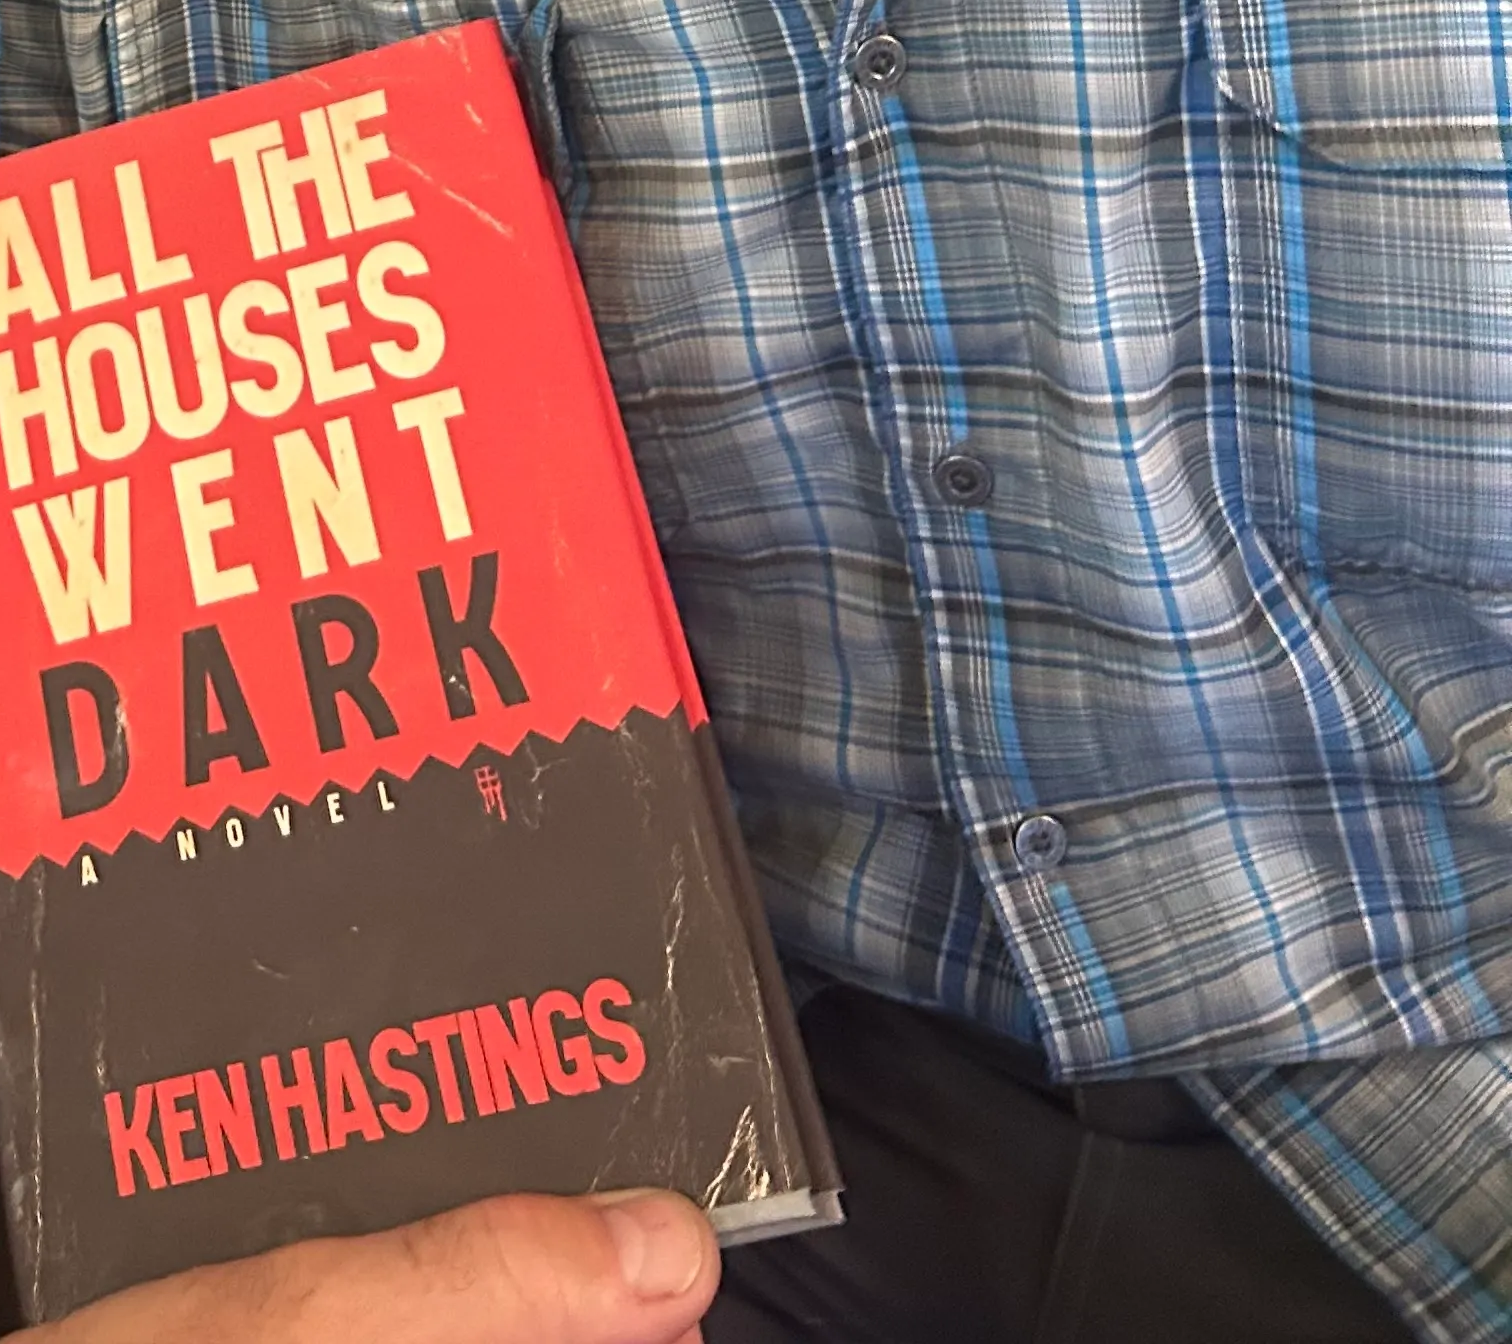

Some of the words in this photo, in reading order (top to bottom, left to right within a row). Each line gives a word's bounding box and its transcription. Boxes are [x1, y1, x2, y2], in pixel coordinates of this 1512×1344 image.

[211, 89, 416, 261] THE
[12, 387, 475, 646] WENT
[38, 549, 532, 821] DARK
[80, 855, 100, 887] A
[176, 781, 396, 861] NOVEL
[102, 1062, 263, 1197] KEN
[262, 976, 648, 1162] HASTINGS
